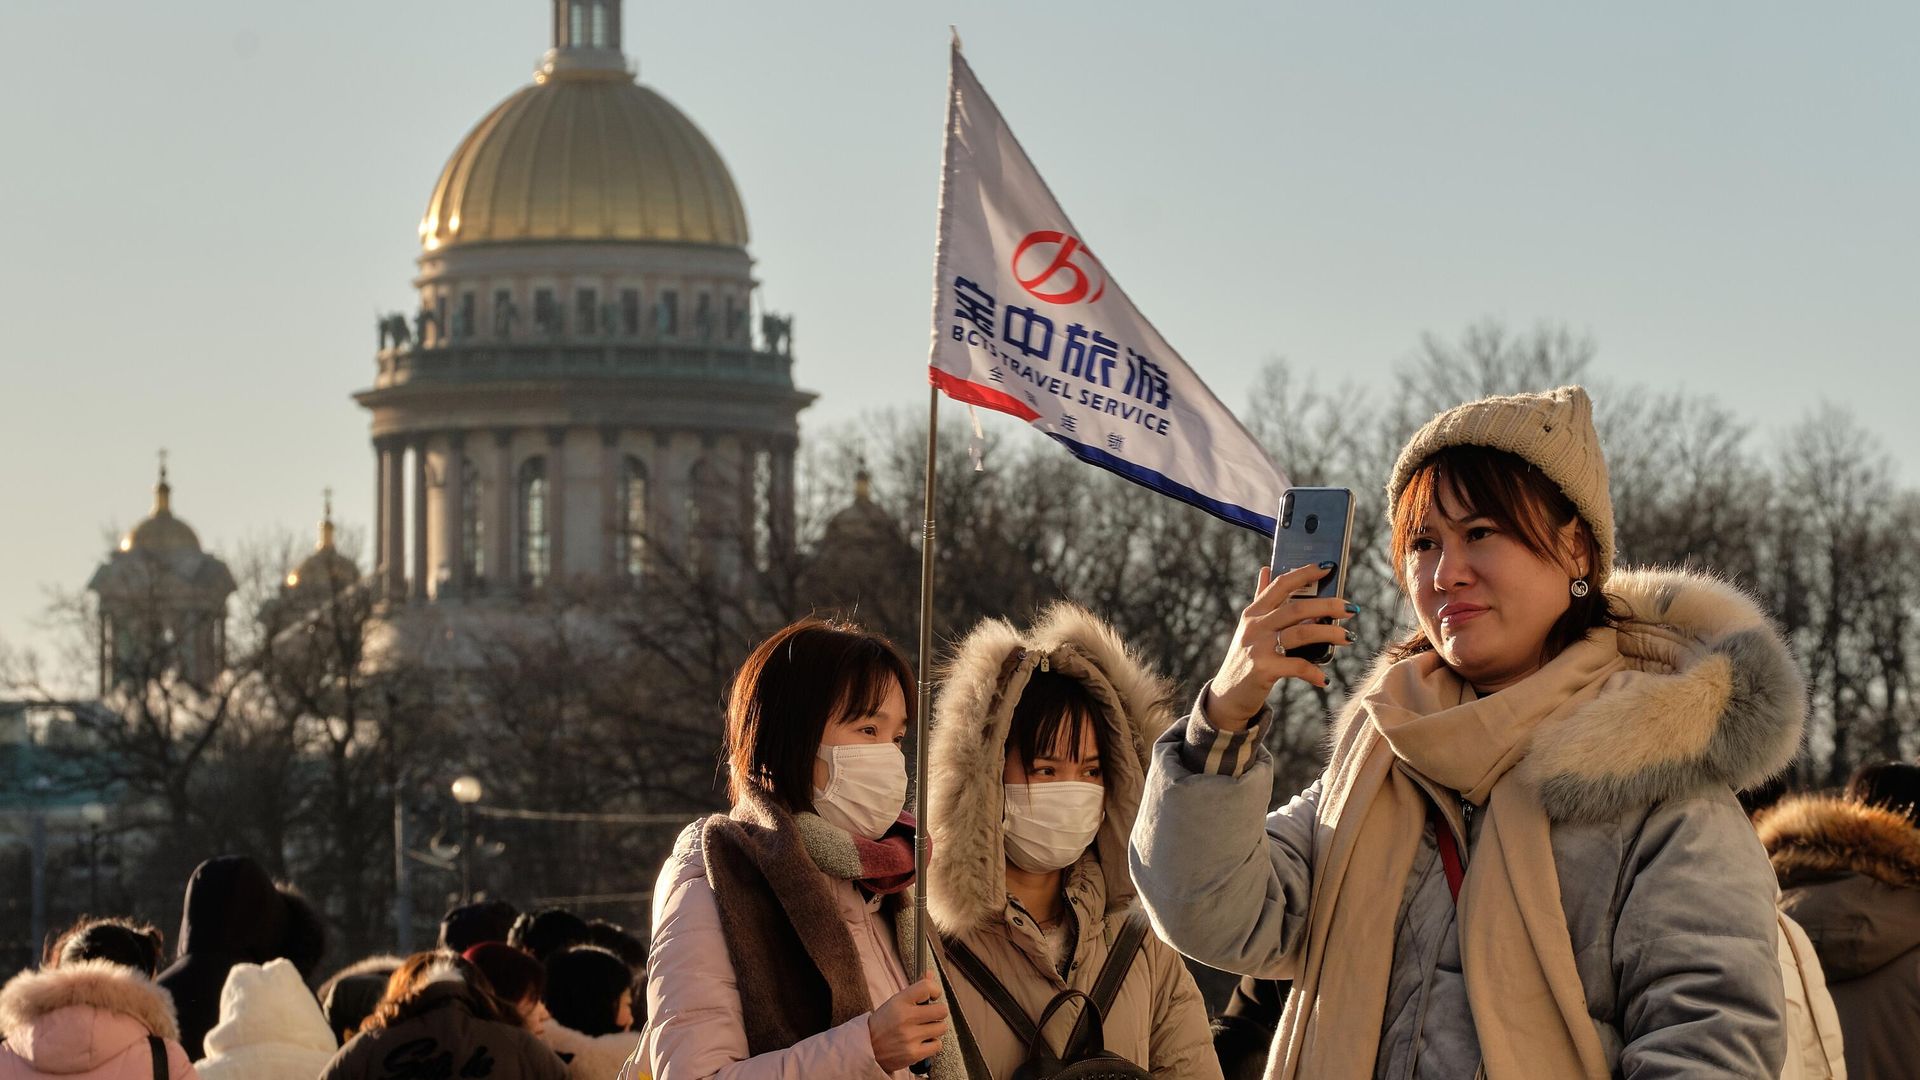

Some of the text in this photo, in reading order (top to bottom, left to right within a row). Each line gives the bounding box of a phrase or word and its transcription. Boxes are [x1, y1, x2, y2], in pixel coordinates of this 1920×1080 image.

[952, 325, 1170, 436] BCTS TRAVEL SERVICE
[954, 275, 1171, 410] 宝中旅游
